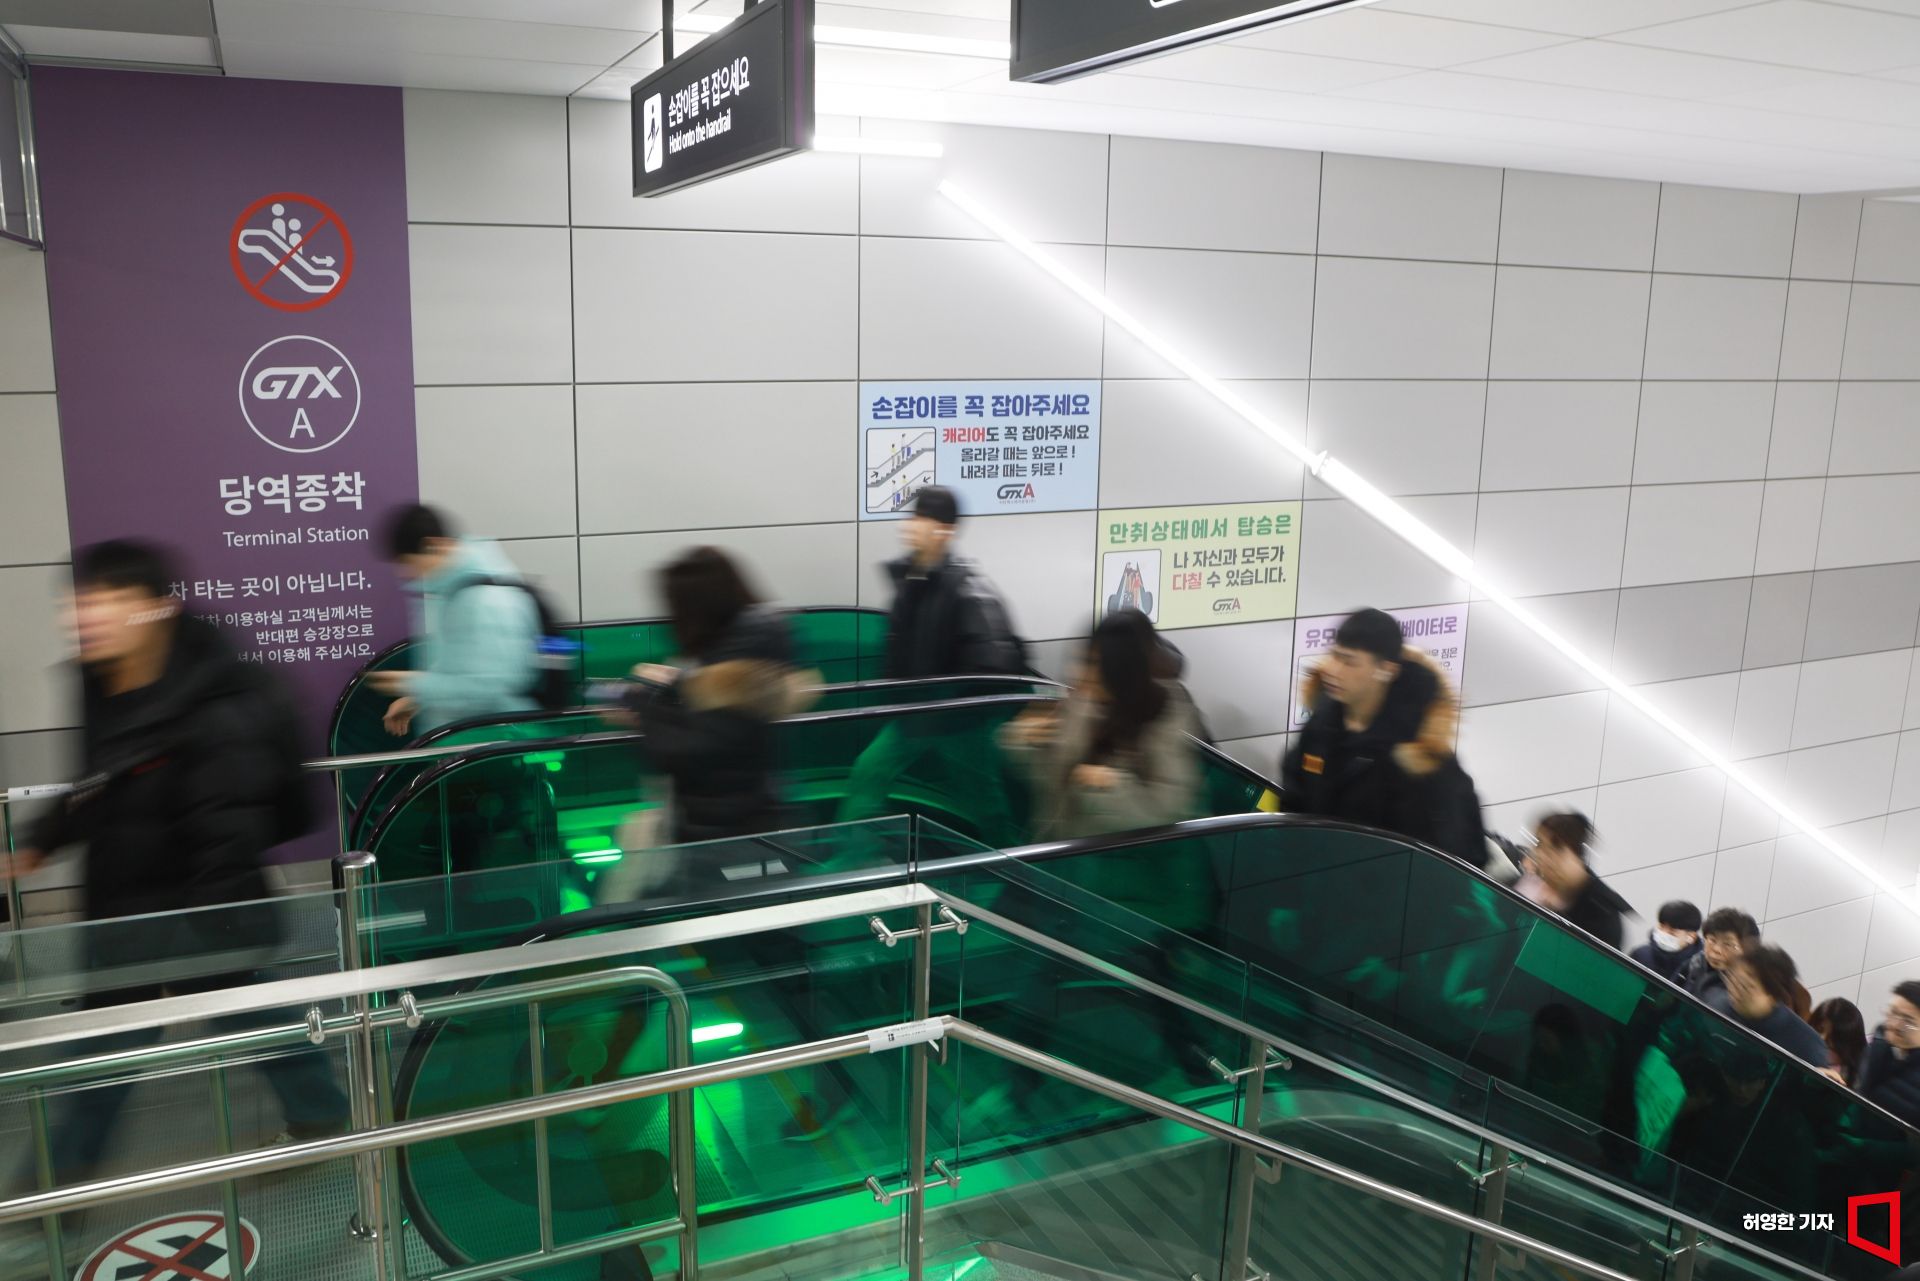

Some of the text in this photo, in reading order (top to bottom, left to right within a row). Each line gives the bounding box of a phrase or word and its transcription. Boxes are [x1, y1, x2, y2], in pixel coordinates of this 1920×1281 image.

[668, 56, 750, 128] 손잡이를 꼭 잡으세요
[669, 107, 731, 154] Hold onto the handrail
[252, 366, 343, 400] GTX
[872, 394, 1090, 420] 손잡이를 꼭 잡아주세요
[290, 407, 315, 438] A
[942, 425, 1089, 443] 캐리어도 꼭 잡아주세요
[961, 447, 999, 462] 올라갈
[1003, 446, 1028, 461] 때는
[960, 464, 999, 479] 내려갈
[1003, 463, 1028, 478] 때는
[219, 471, 366, 516] 당역종착
[223, 525, 369, 548] Terminal Station
[1110, 514, 1291, 544] 만취상태에서 탑승은
[1173, 545, 1285, 569] 나 자신과 모두가
[168, 570, 372, 601] 차 타는 곳이 아닙니다.
[1172, 566, 1287, 591] 다칠 수 있습니다.
[225, 610, 283, 628] 이용하실
[287, 604, 373, 624] 고객님께서는
[256, 623, 375, 645] 반대편 승강장으로
[1305, 616, 1458, 649] 유모 베이터로
[238, 642, 376, 665] 셔서 이용해 주십시오.
